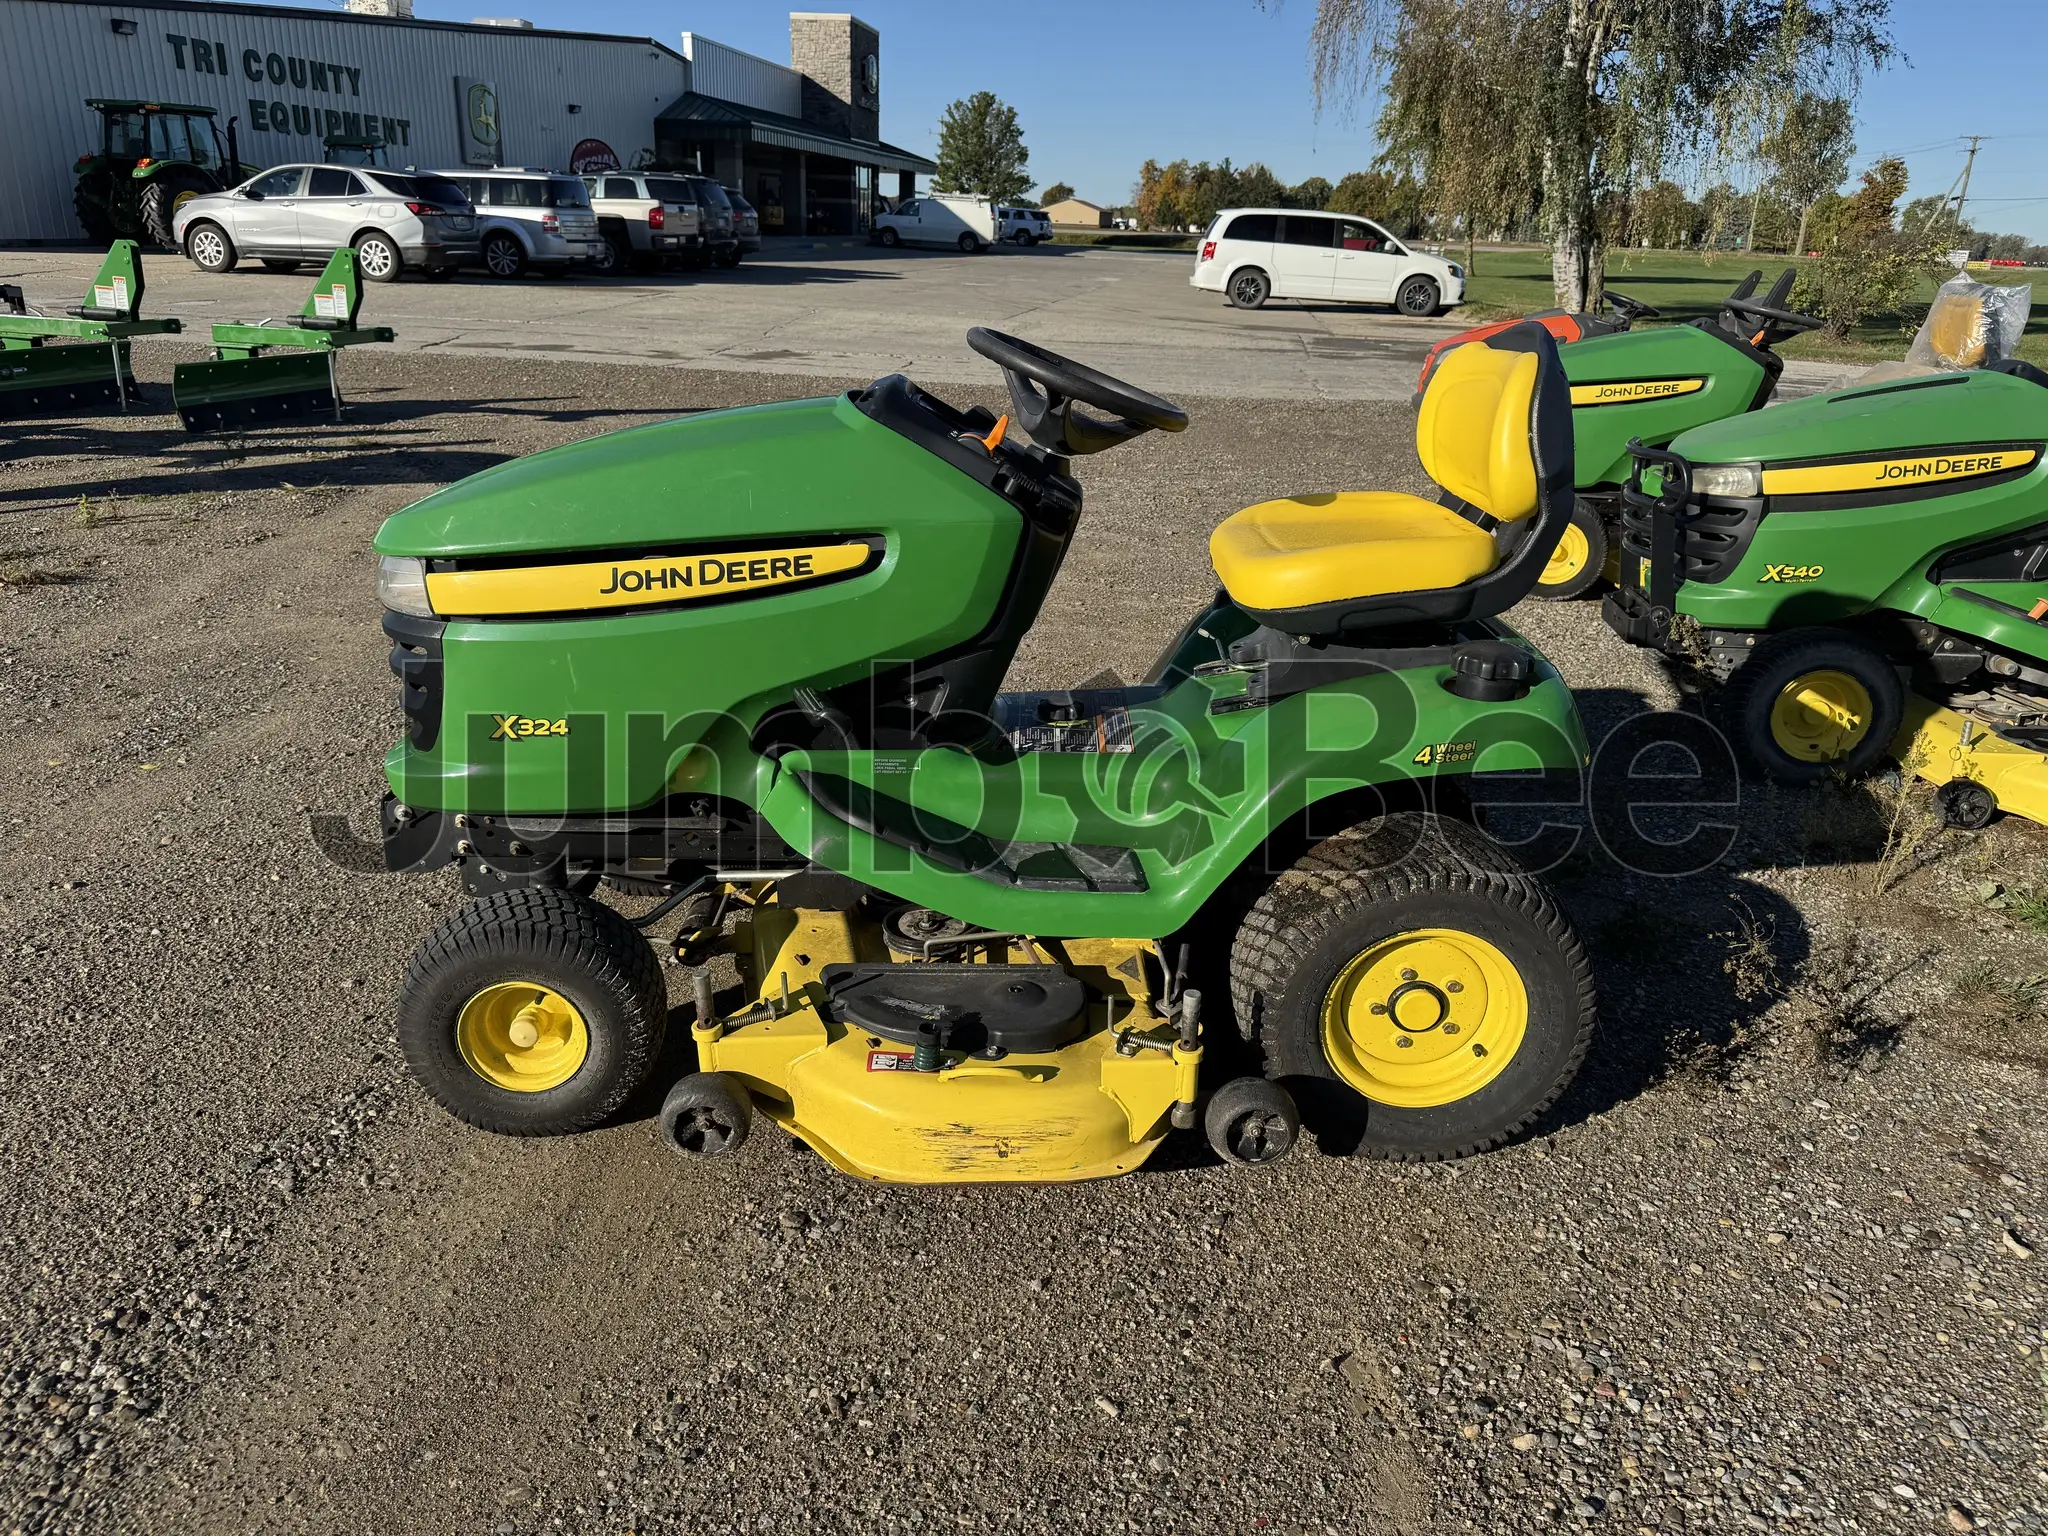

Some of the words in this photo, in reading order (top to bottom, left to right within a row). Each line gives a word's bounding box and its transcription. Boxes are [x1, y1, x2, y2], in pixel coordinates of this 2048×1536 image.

[166, 33, 228, 76] TRI
[243, 49, 361, 96] COUNTY
[249, 99, 410, 146] EQUIPMENT
[1596, 387, 1633, 398] JOHN
[1634, 384, 1680, 395] DEERE
[1876, 463, 1932, 480] JOHN
[1935, 456, 2003, 474] DEERE
[600, 566, 693, 594] JOHN
[699, 554, 814, 586] DEERE
[1758, 564, 1824, 582] X540
[489, 714, 570, 741] X324
[1413, 745, 1433, 765] 4
[1435, 740, 1477, 754] Wheel
[1434, 751, 1475, 764] Steer
